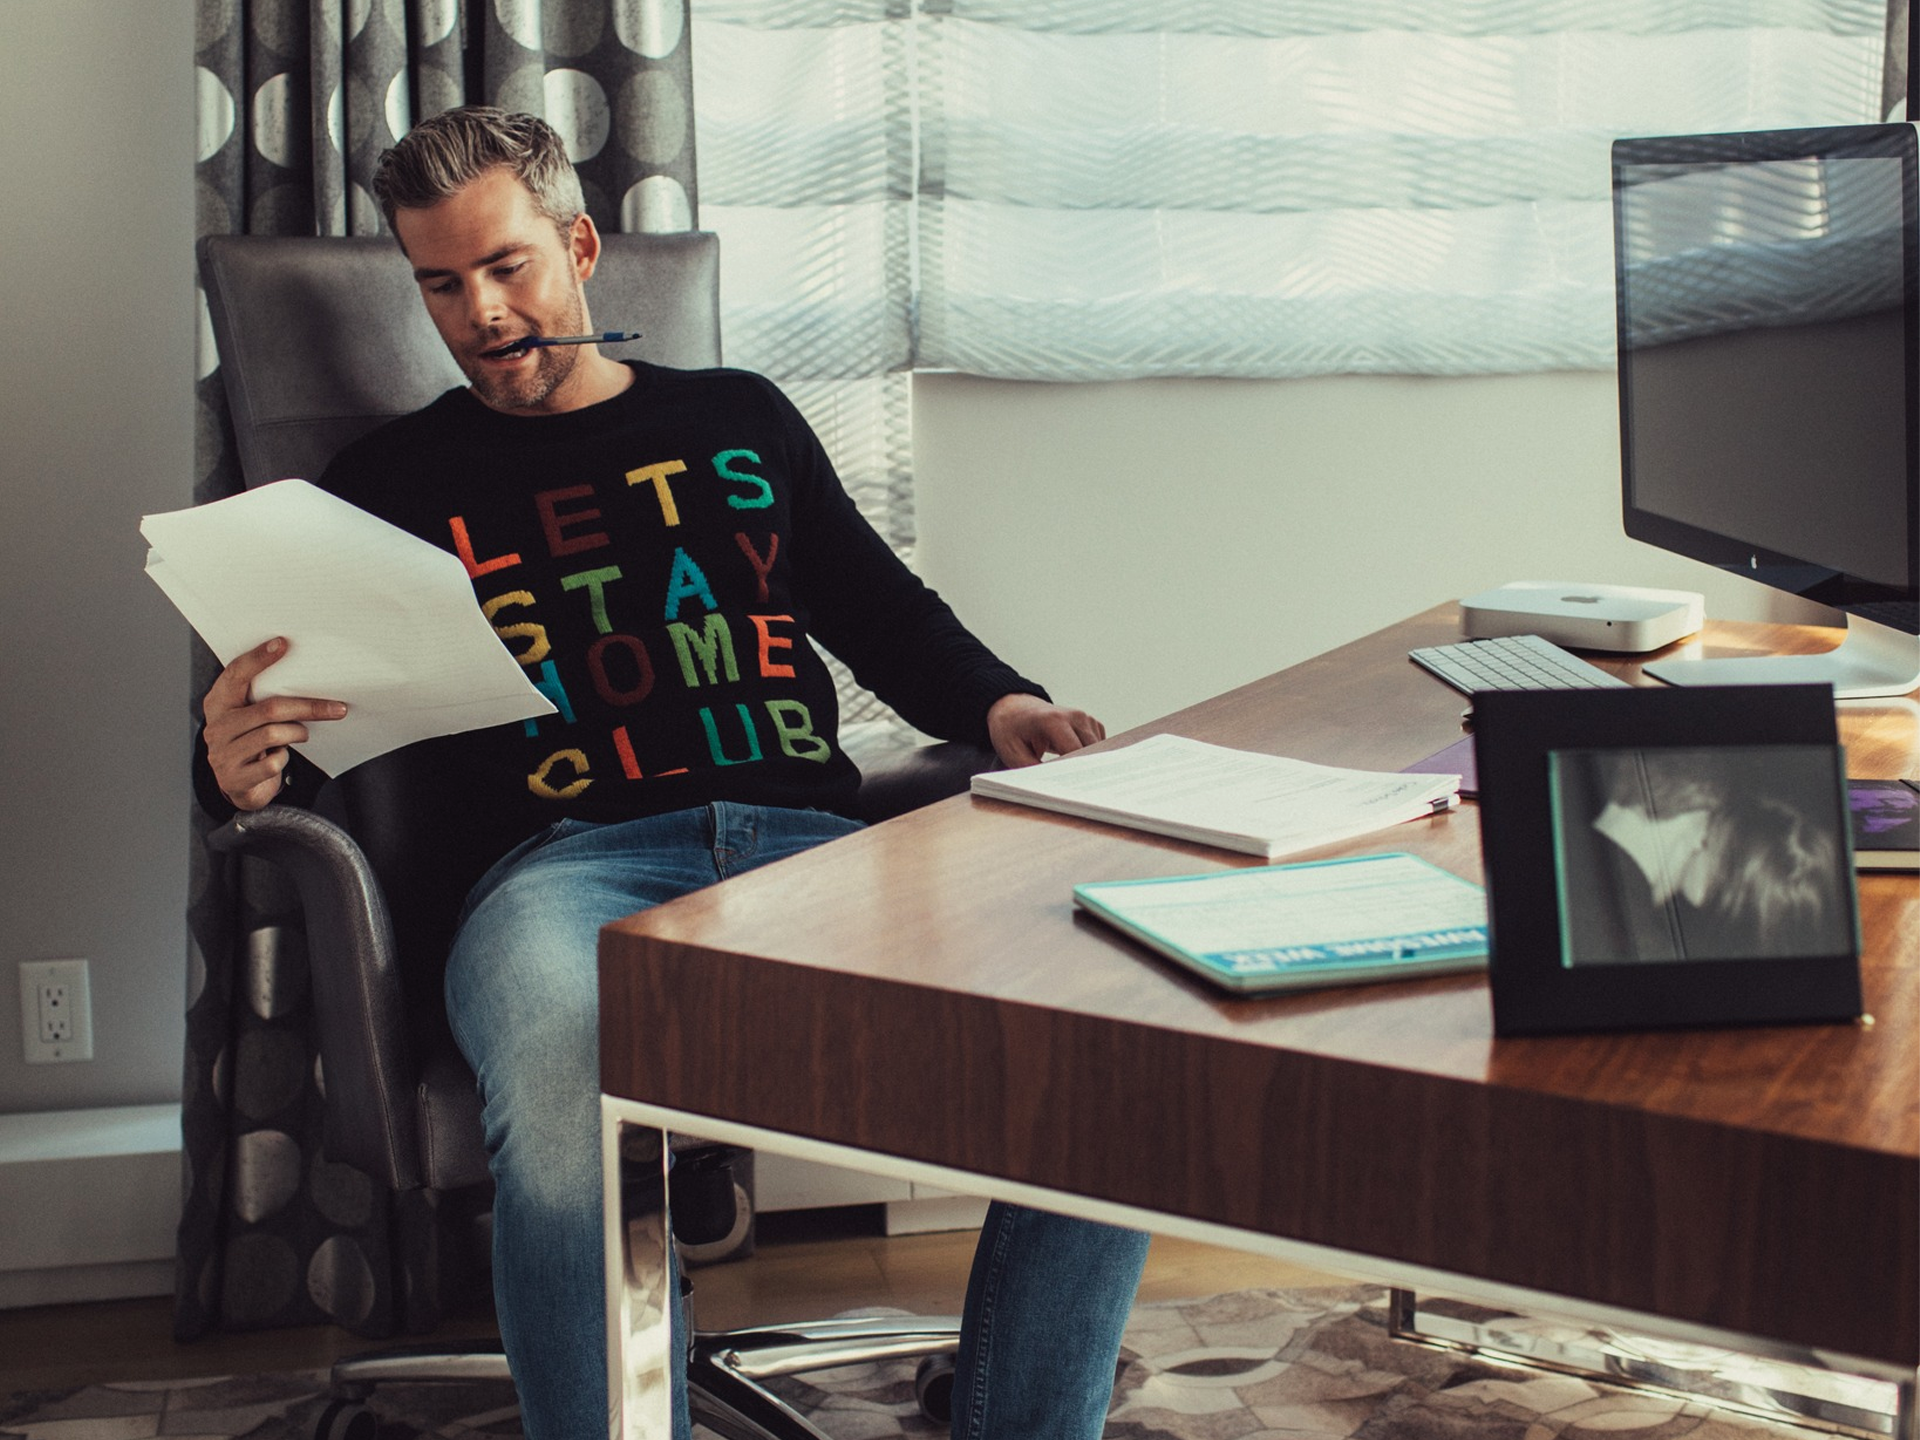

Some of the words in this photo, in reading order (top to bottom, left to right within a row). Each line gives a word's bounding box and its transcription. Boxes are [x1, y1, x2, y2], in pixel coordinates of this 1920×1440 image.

[448, 448, 775, 579] LETS
[481, 531, 779, 666] STAY
[527, 699, 831, 799] CLUB
